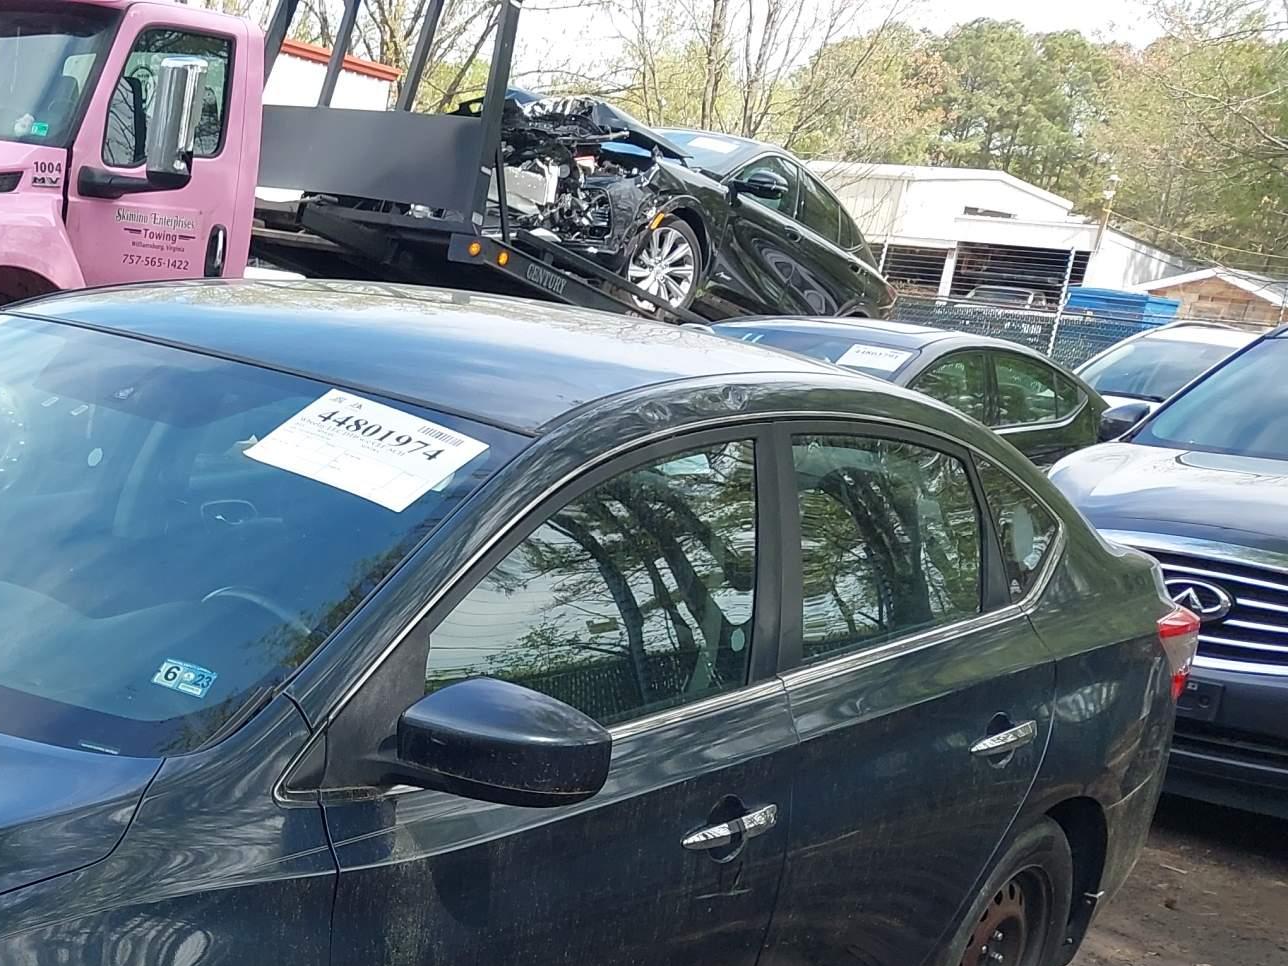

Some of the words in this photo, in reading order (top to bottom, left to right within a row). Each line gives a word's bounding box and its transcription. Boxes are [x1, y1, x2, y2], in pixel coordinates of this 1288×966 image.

[33, 161, 62, 174] 1004
[151, 212, 195, 230] Enterprises
[143, 228, 177, 245] Towing
[122, 253, 189, 271] 757-565-1422
[526, 262, 568, 295] CENTURY
[317, 410, 445, 461] 44801974
[163, 665, 181, 681] 6
[192, 673, 213, 689] 23
